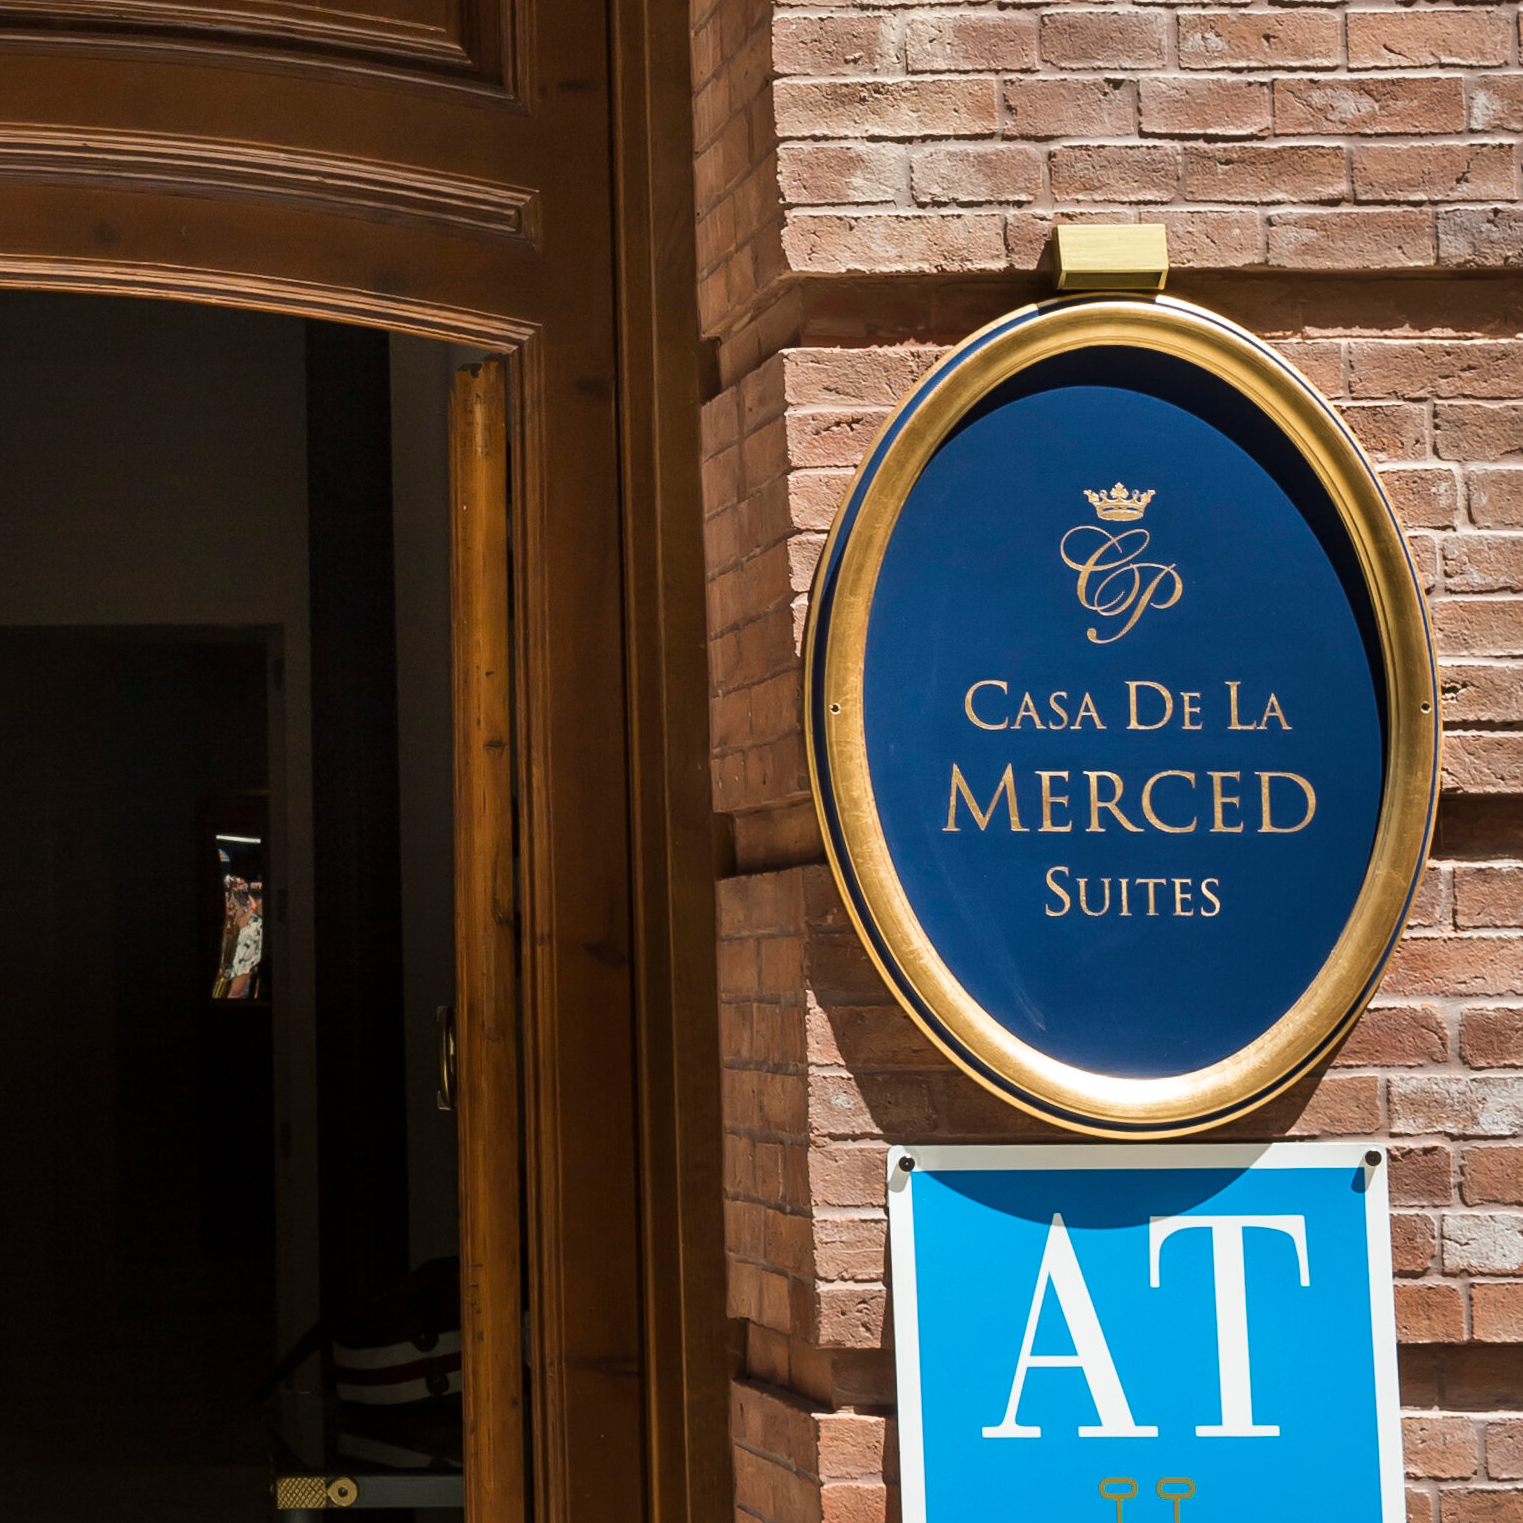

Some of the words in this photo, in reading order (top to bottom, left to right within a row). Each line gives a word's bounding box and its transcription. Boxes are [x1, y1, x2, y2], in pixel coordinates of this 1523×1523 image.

[941, 761, 1318, 836] MERCED
[1044, 865, 1222, 918] SUITES
[980, 1212, 1311, 1439] AT
